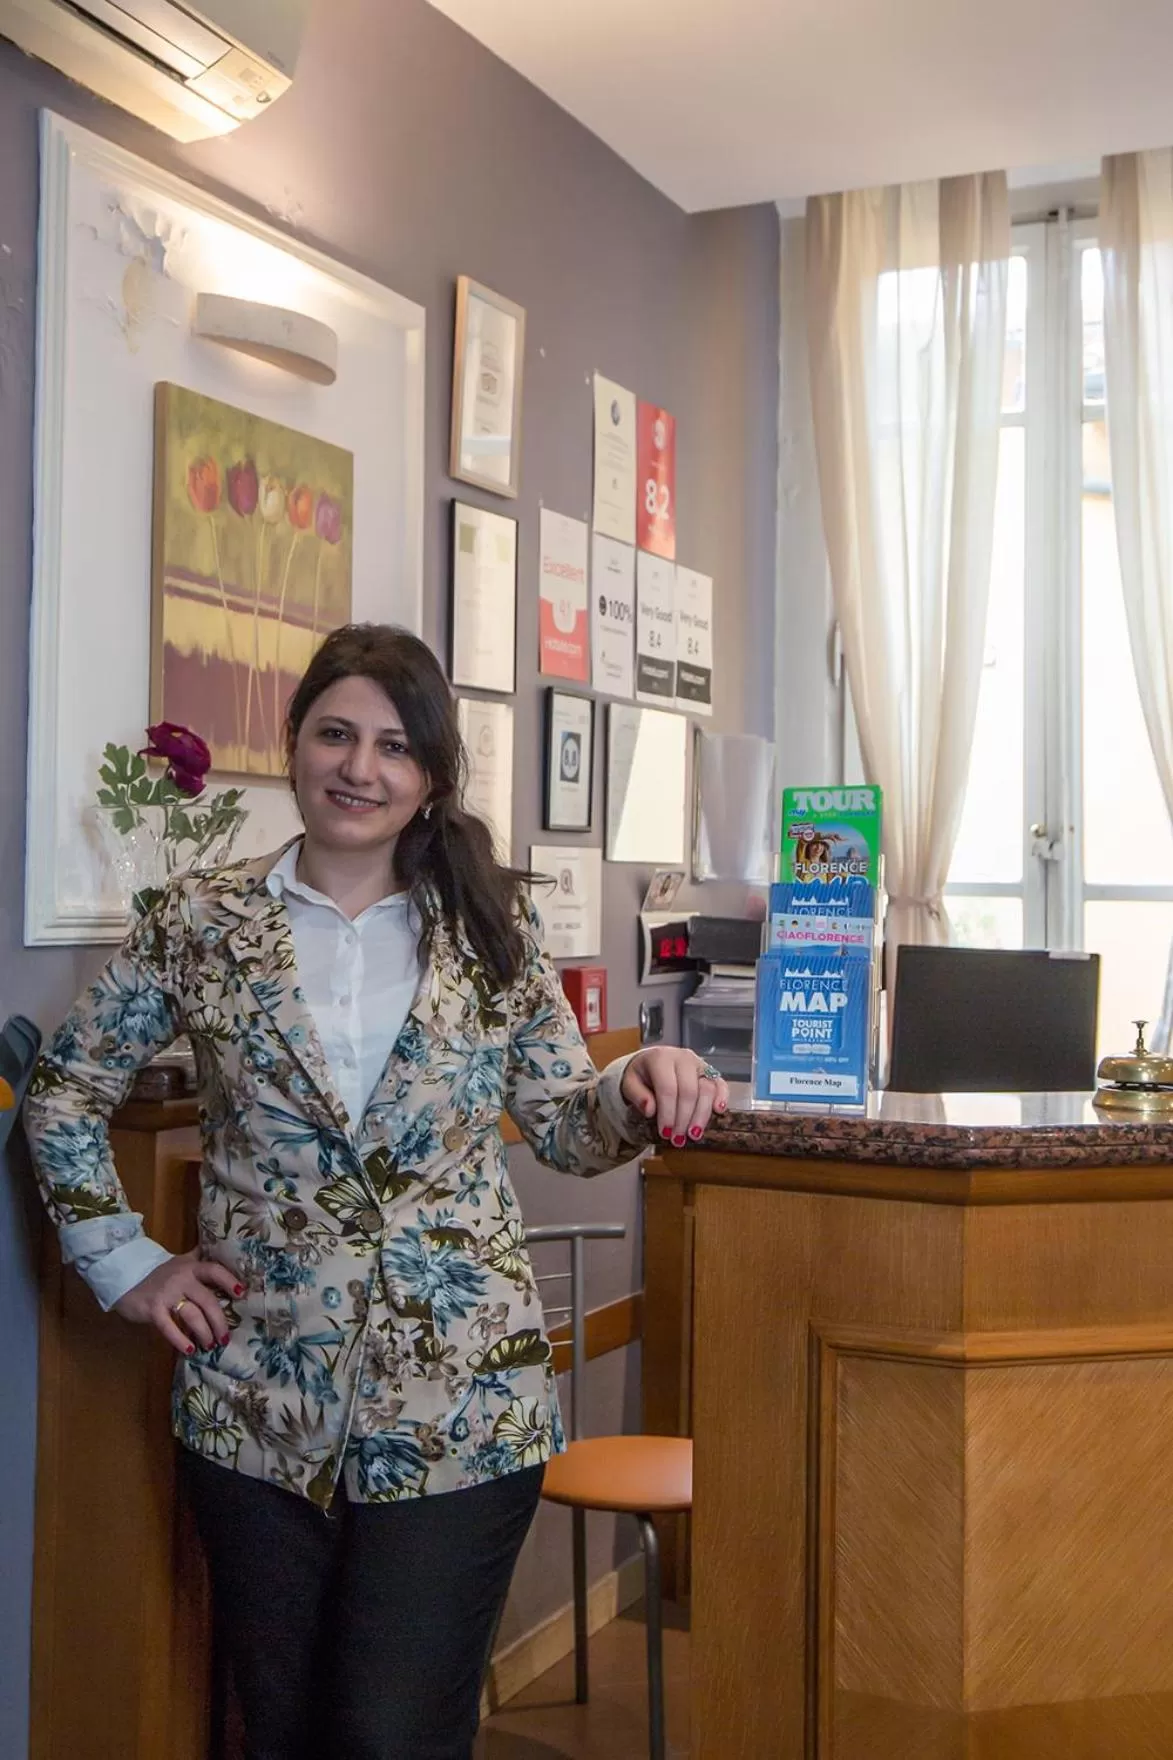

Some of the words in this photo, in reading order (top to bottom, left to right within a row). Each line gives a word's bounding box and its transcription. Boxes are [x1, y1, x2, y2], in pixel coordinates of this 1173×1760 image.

[543, 555, 585, 585] Excellent
[609, 600, 633, 623] 100%
[641, 602, 654, 620] Very
[655, 606, 673, 623] Good
[693, 614, 709, 631] Good
[792, 788, 876, 812] TOUR
[795, 861, 868, 874] FLORENCE
[776, 930, 865, 944] CIAOFLORENCE
[780, 979, 848, 991] FLORENCE
[779, 991, 848, 1013] MAP
[792, 1018, 834, 1028] TOURIST
[791, 1028, 833, 1039] POINT
[790, 1077, 822, 1086] Florence
[824, 1078, 842, 1088] Map
